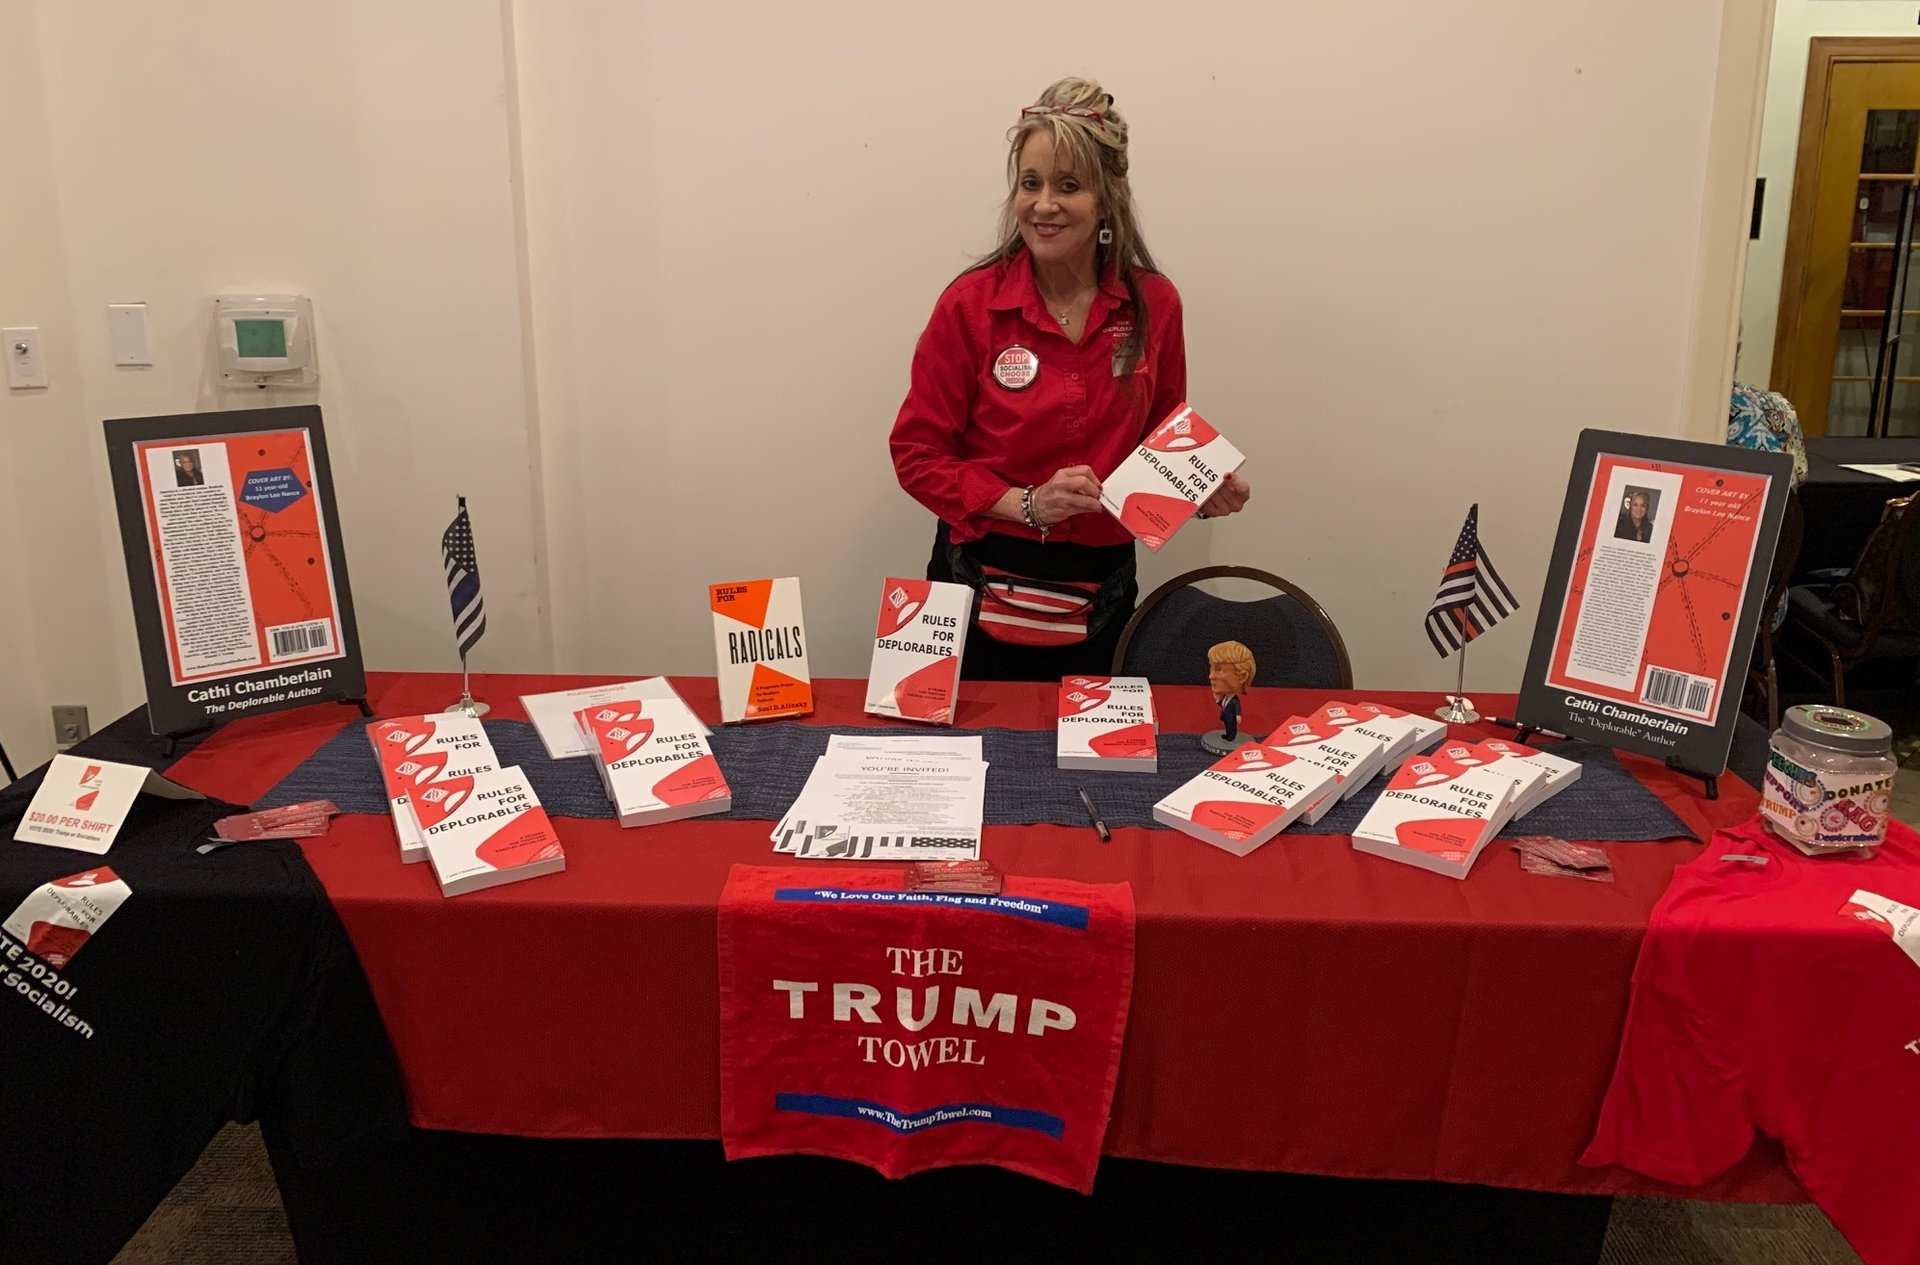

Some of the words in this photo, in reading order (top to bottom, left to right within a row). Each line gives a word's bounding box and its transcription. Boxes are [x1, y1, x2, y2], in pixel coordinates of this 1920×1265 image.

[1004, 353, 1028, 364] STOP
[1138, 447, 1199, 502] DEPLORABLES
[1188, 455, 1218, 482] RULES
[1188, 473, 1208, 493] FOR
[1695, 486, 1720, 496] COVER
[1721, 490, 1739, 499] ART
[1738, 492, 1750, 500] BY
[1712, 510, 1726, 518] Lee
[1727, 512, 1751, 522] Nance
[716, 586, 747, 596] RULES
[717, 594, 735, 602] FOR
[922, 614, 957, 628] RULES
[728, 625, 803, 665] RADICALS
[932, 630, 954, 642] FOR
[877, 639, 953, 657] DEPLORABLES
[188, 684, 231, 703] Cathi
[235, 667, 332, 694] Chamberlain
[204, 705, 225, 714] The
[228, 692, 285, 711] Deplorable
[287, 686, 322, 699] Author
[1564, 695, 1600, 713] Cathi
[1601, 704, 1689, 736] Chamberlain
[1354, 727, 1393, 743] RULES
[1568, 711, 1585, 724] The
[1588, 716, 1642, 737] "Deplorable"
[1642, 731, 1677, 747] Author
[436, 733, 478, 745] RULES
[454, 741, 482, 750] FOR
[656, 733, 696, 745] RULES
[674, 741, 700, 751] FOR
[611, 750, 704, 771] DEPLORABLES
[1318, 744, 1357, 760] RULES
[1324, 755, 1350, 767] FOR
[448, 764, 492, 778] RULES
[1203, 770, 1285, 806] DEPLORABLES
[1266, 772, 1305, 791] RULES
[1824, 777, 1892, 800] DONATE
[477, 784, 523, 801] RULES
[499, 793, 528, 806] FOR
[1270, 784, 1295, 799] FOR
[1449, 784, 1495, 801] RULES
[1385, 790, 1483, 818] DEPLORABLES
[1460, 797, 1488, 810] FOR
[29, 812, 59, 825] $20.00
[60, 816, 80, 828] PER
[81, 820, 114, 833] SHIRT
[428, 802, 532, 835] DEPLORABLES
[47, 887, 89, 930] DEPLORABLES
[81, 896, 104, 917] RULES
[814, 890, 838, 900] “We
[840, 892, 869, 900] Love
[872, 892, 895, 900] Our
[898, 893, 933, 902] Faith,
[935, 895, 961, 904] Flag
[965, 896, 987, 905] and
[990, 897, 1049, 914] Freedom”
[81, 909, 96, 923] FOR
[0, 936, 24, 961] TE
[18, 957, 78, 1000] 2020!
[887, 947, 963, 978] THE
[3, 972, 95, 1039] Socialism
[773, 979, 1077, 1037] TRUMP
[857, 1036, 985, 1072] TOWEL
[857, 1106, 992, 1130] www.TheTrumpTowel.com
